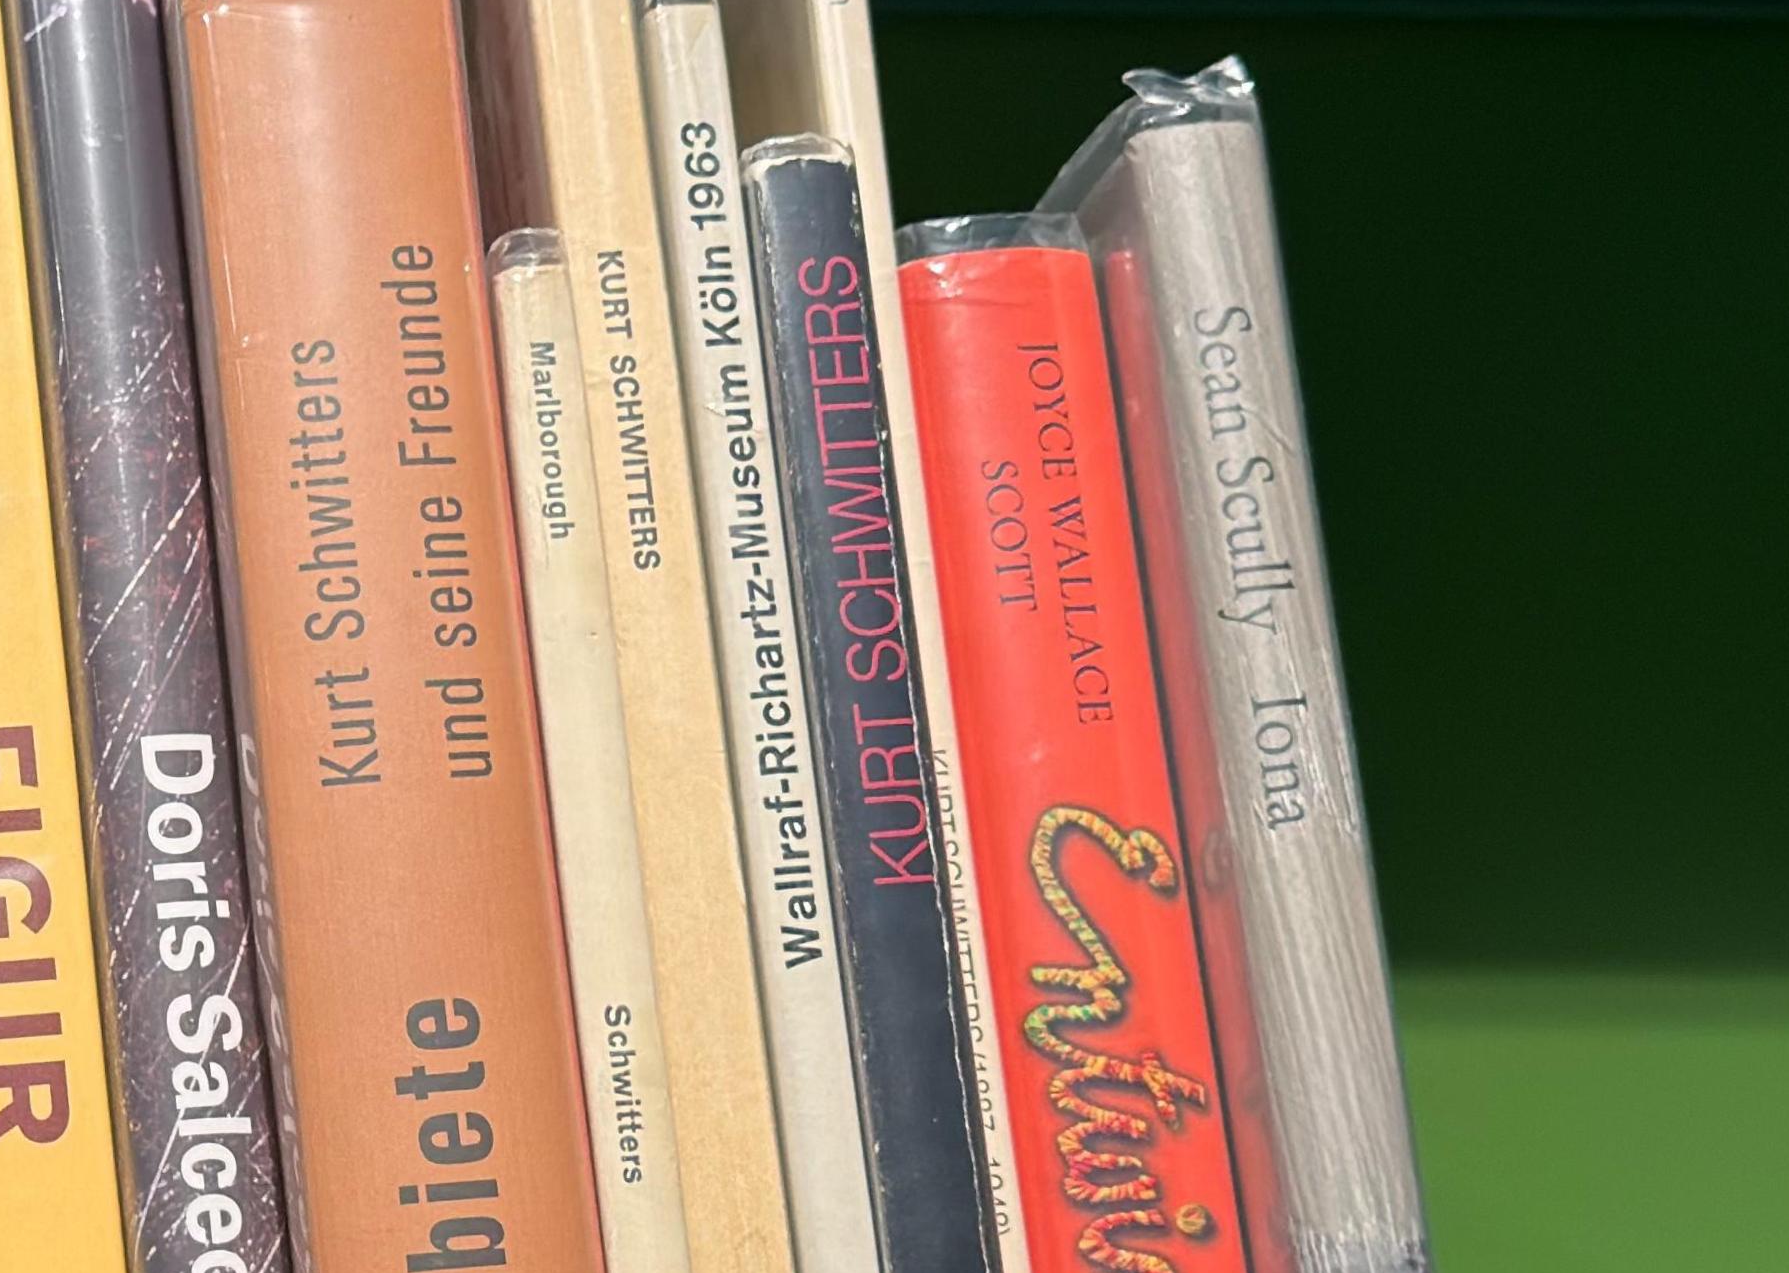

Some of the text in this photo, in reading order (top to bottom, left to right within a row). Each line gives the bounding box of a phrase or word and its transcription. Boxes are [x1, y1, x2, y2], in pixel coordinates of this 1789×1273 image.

[288, 340, 382, 787] Kurt Schwitters
[380, 243, 494, 779] und seine Freunde
[596, 250, 661, 571] KURT SCHWITTERS
[680, 121, 824, 967] Wallraf-Richartz-Museum Köln 1963
[798, 256, 934, 886] KURT SCHWITTERS
[981, 460, 1038, 611] SCOTT
[1018, 343, 1114, 725] JOYCE WALLACE
[1193, 306, 1310, 830] Sean Scully Iona
[139, 733, 230, 972] Doris
[530, 342, 644, 1184] Marlborough Schwitters
